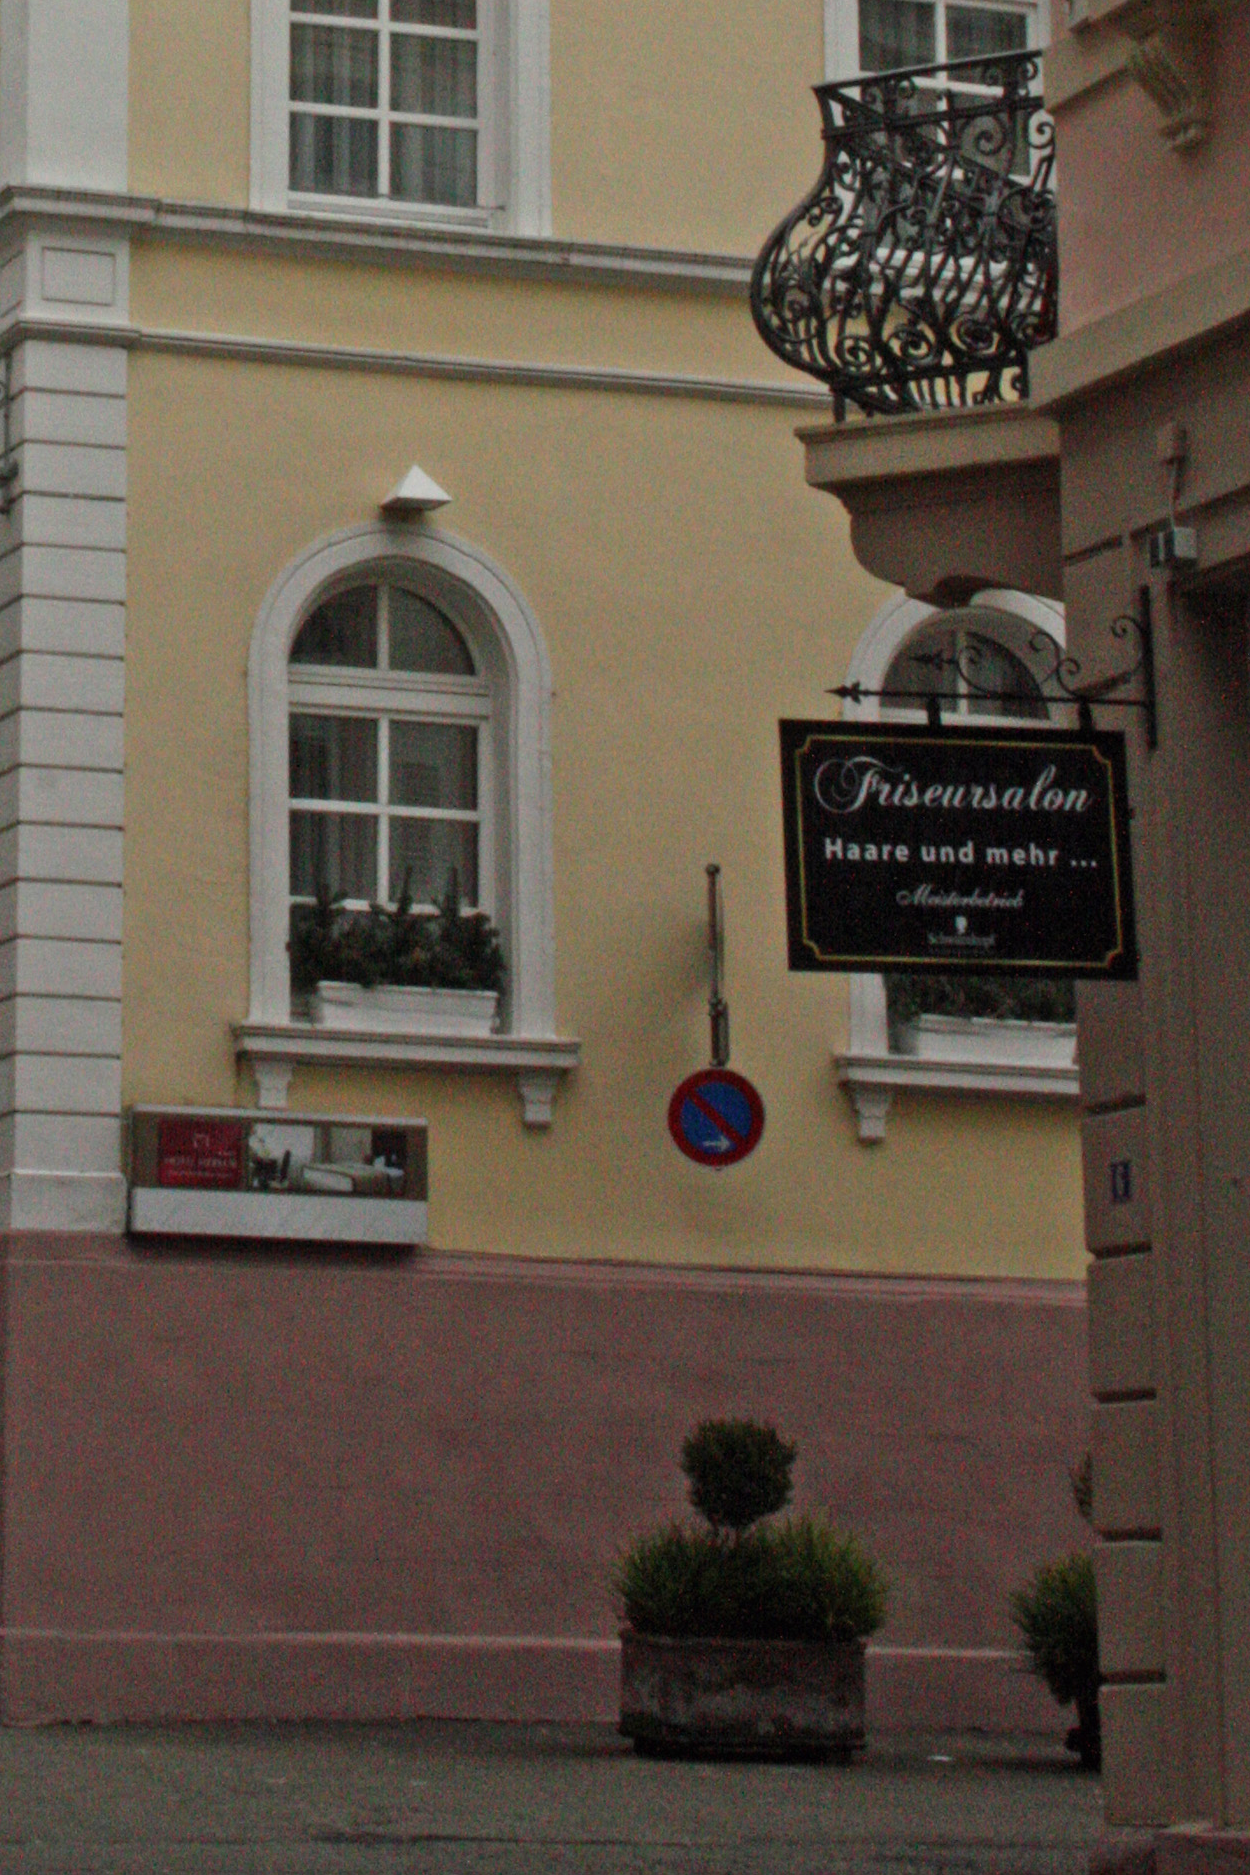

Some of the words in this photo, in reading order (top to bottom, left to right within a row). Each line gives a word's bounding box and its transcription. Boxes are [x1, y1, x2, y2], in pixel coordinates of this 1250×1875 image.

[814, 755, 1092, 814] Friseursalon
[825, 837, 910, 862] Haare
[921, 841, 975, 864] und
[986, 843, 1059, 867] mehr
[895, 884, 1025, 908] Meisterbetrieb
